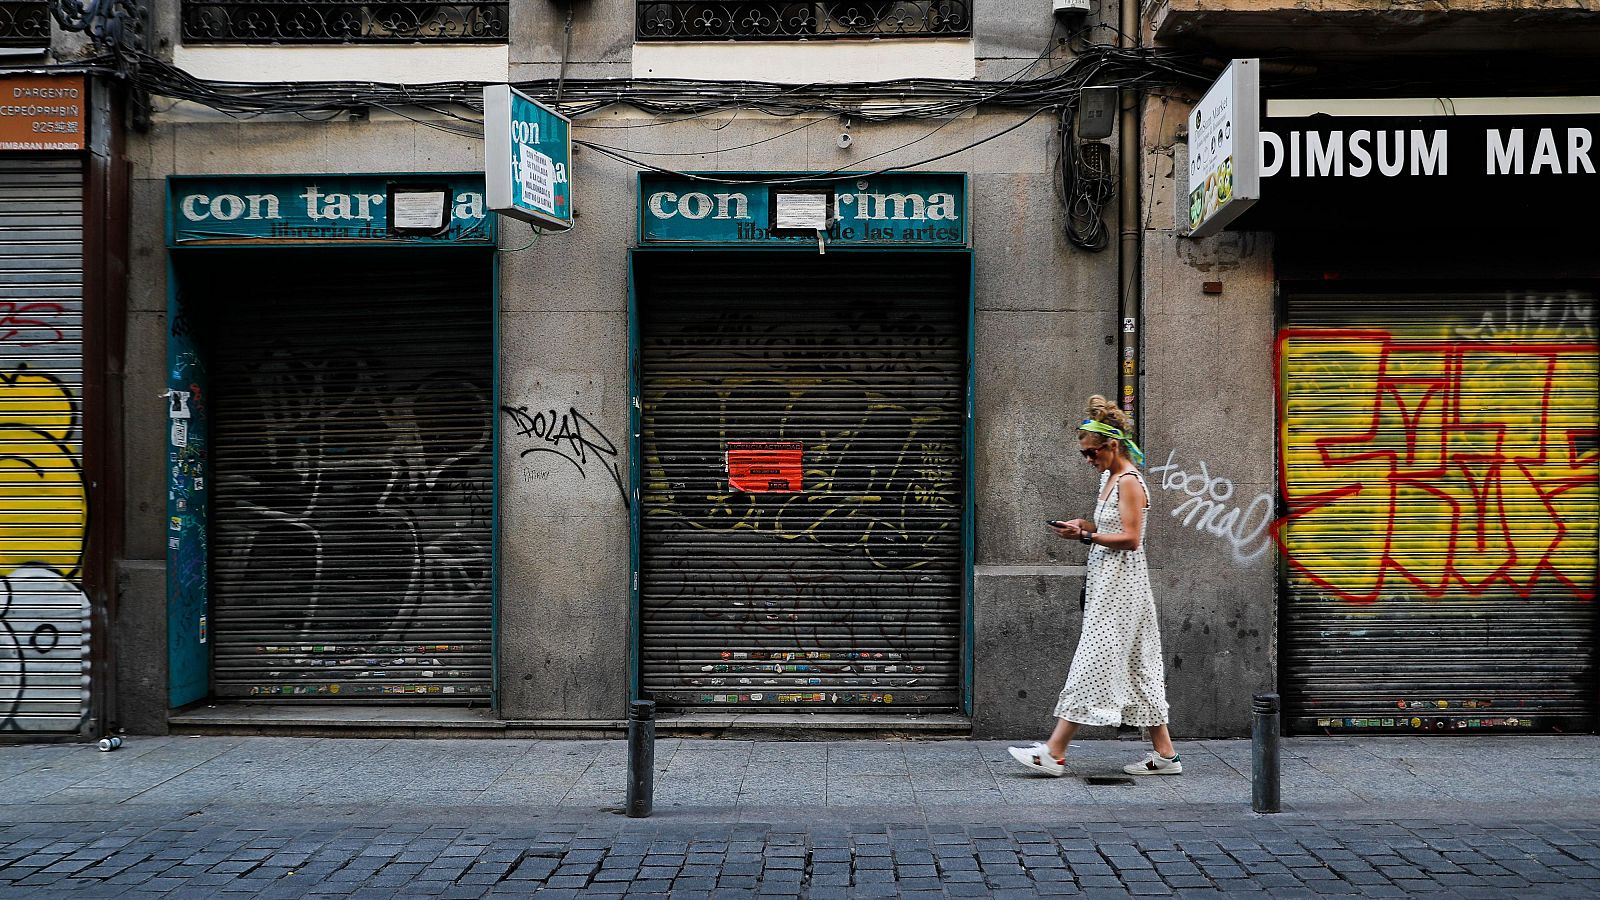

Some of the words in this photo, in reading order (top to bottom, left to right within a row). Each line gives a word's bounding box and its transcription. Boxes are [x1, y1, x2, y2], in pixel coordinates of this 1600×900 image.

[13, 87, 79, 99] D'ARGENTO
[44, 142, 79, 150] MADRID
[511, 120, 540, 145] con
[1259, 130, 1448, 178] DIMSUM
[1486, 127, 1597, 175] MAR
[179, 192, 282, 221] con
[648, 191, 751, 220] con
[863, 223, 895, 240] las
[902, 222, 959, 242] artes
[1149, 448, 1234, 502] todo
